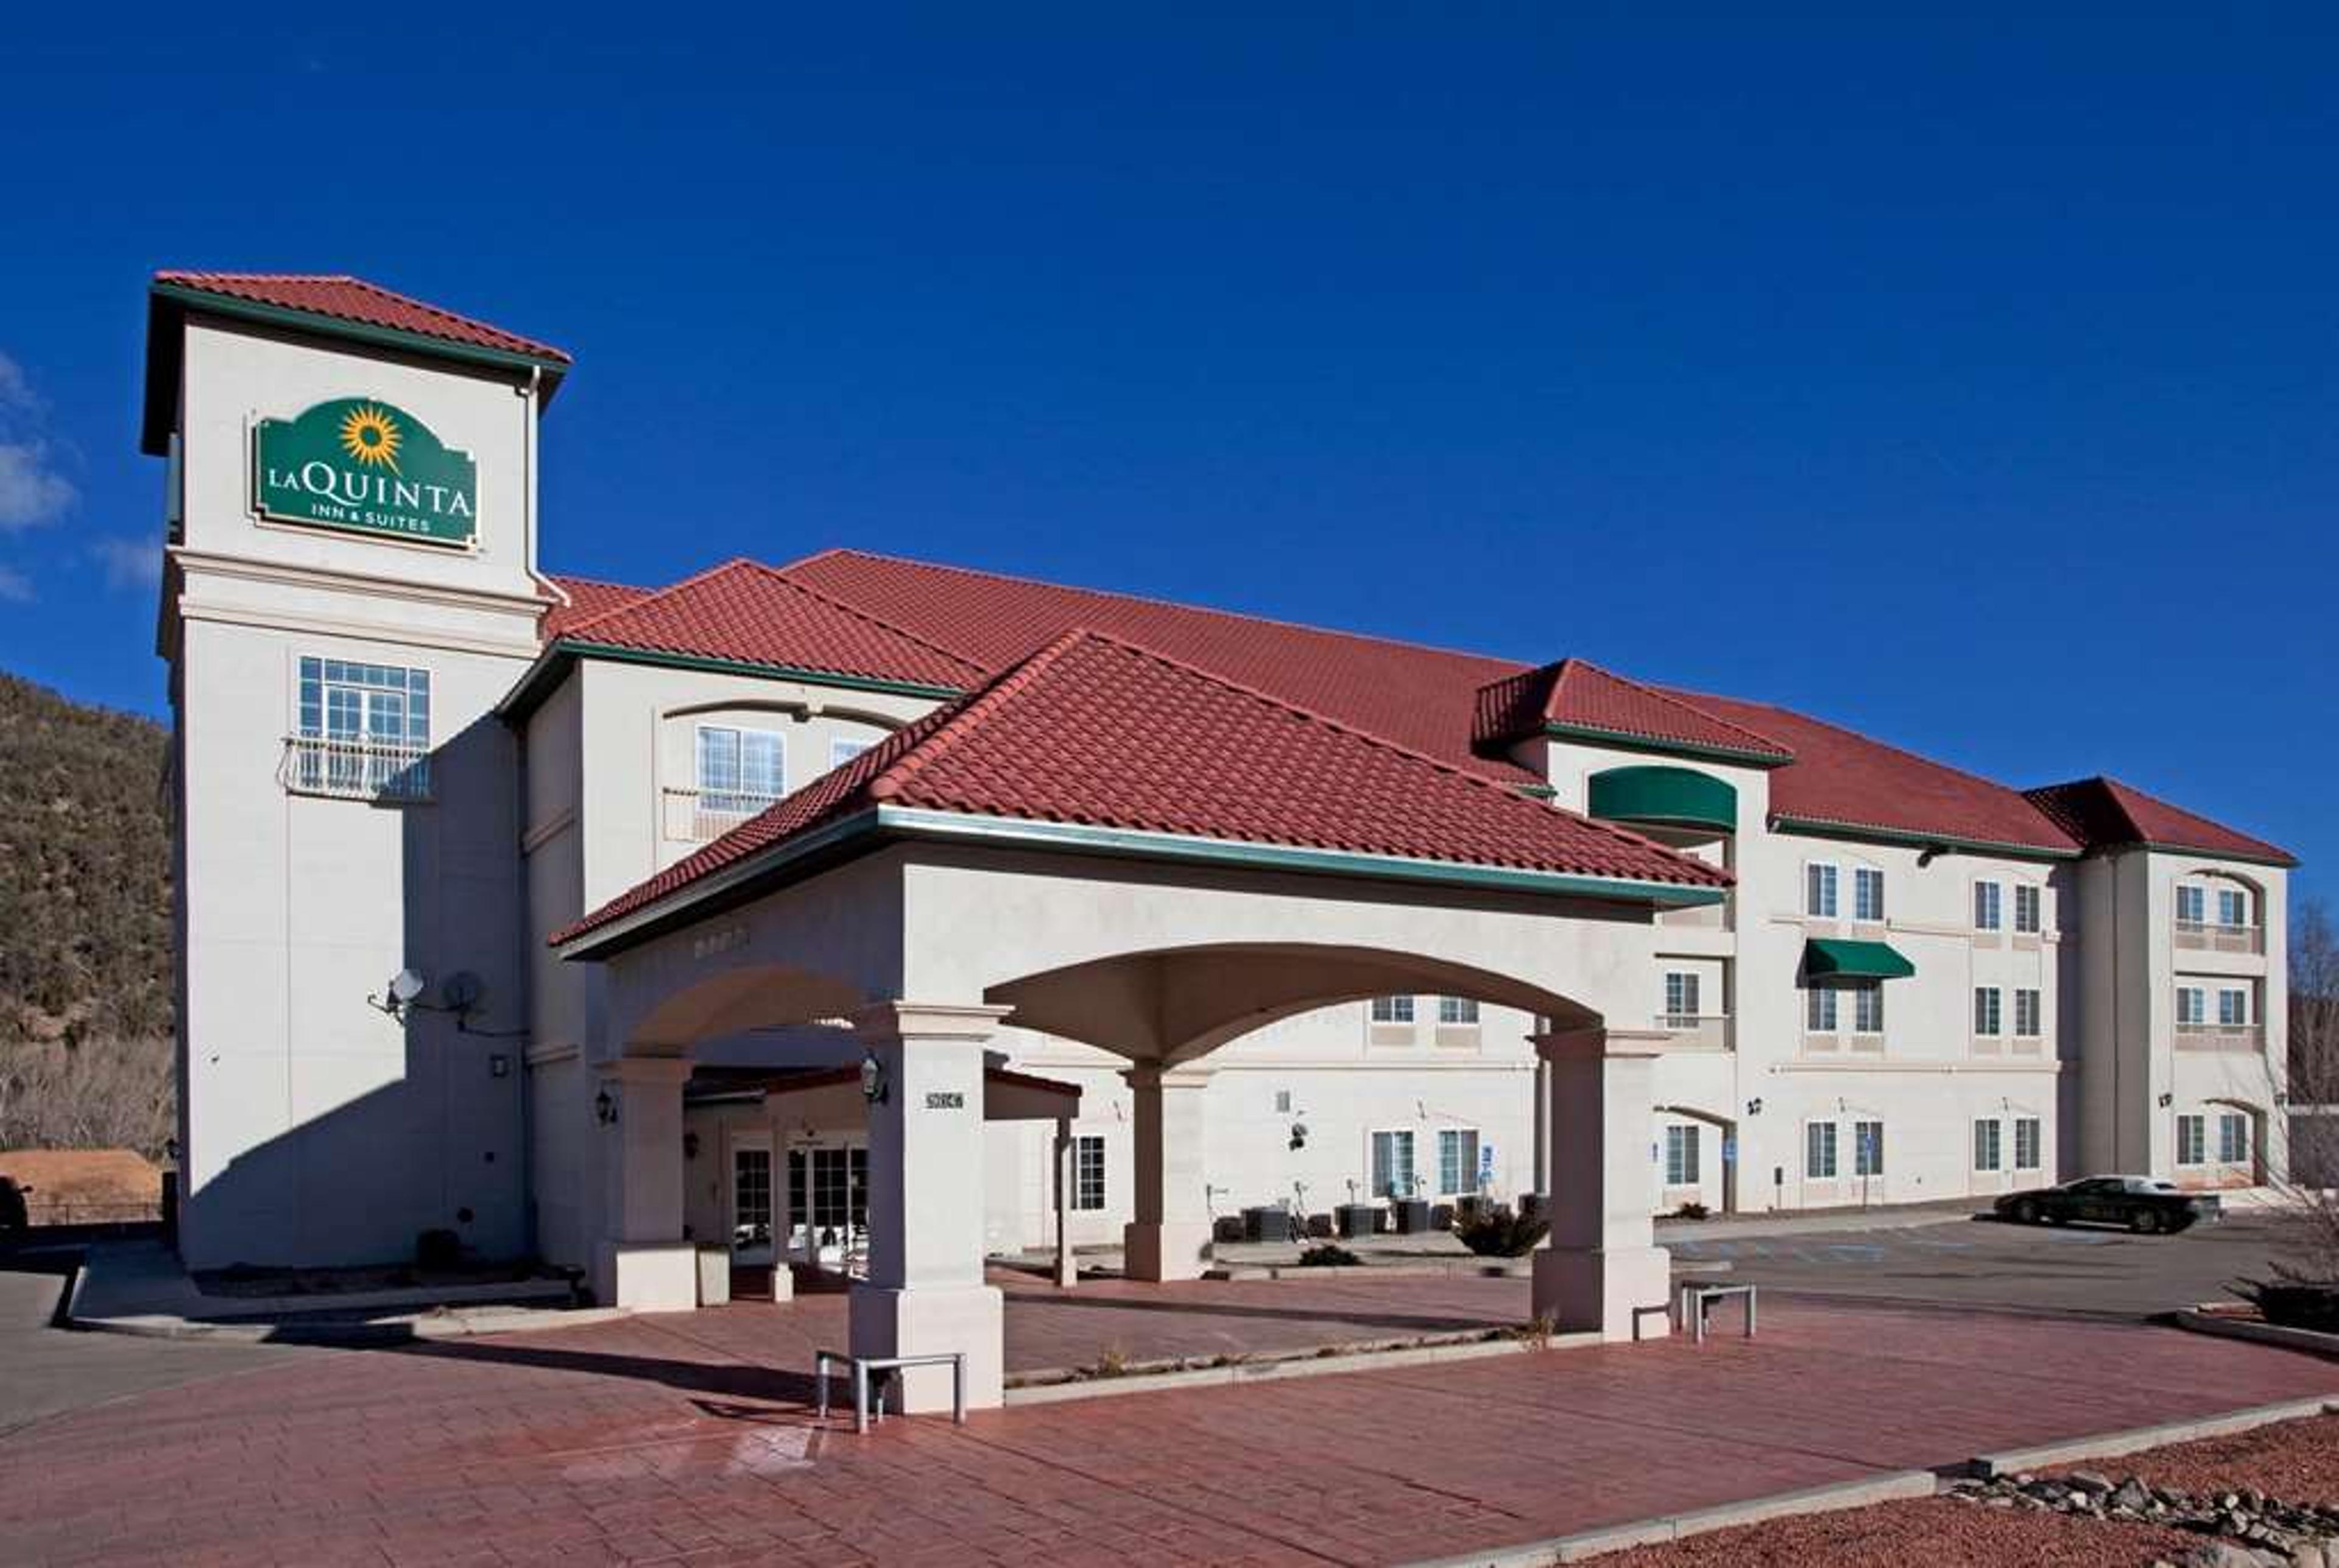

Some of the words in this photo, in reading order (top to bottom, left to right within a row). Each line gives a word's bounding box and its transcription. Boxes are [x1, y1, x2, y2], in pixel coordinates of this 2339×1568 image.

[269, 469, 299, 490] LA
[303, 461, 472, 516] QUINTA
[311, 503, 344, 519] INN
[350, 511, 361, 521] &
[365, 512, 431, 532] SUITES
